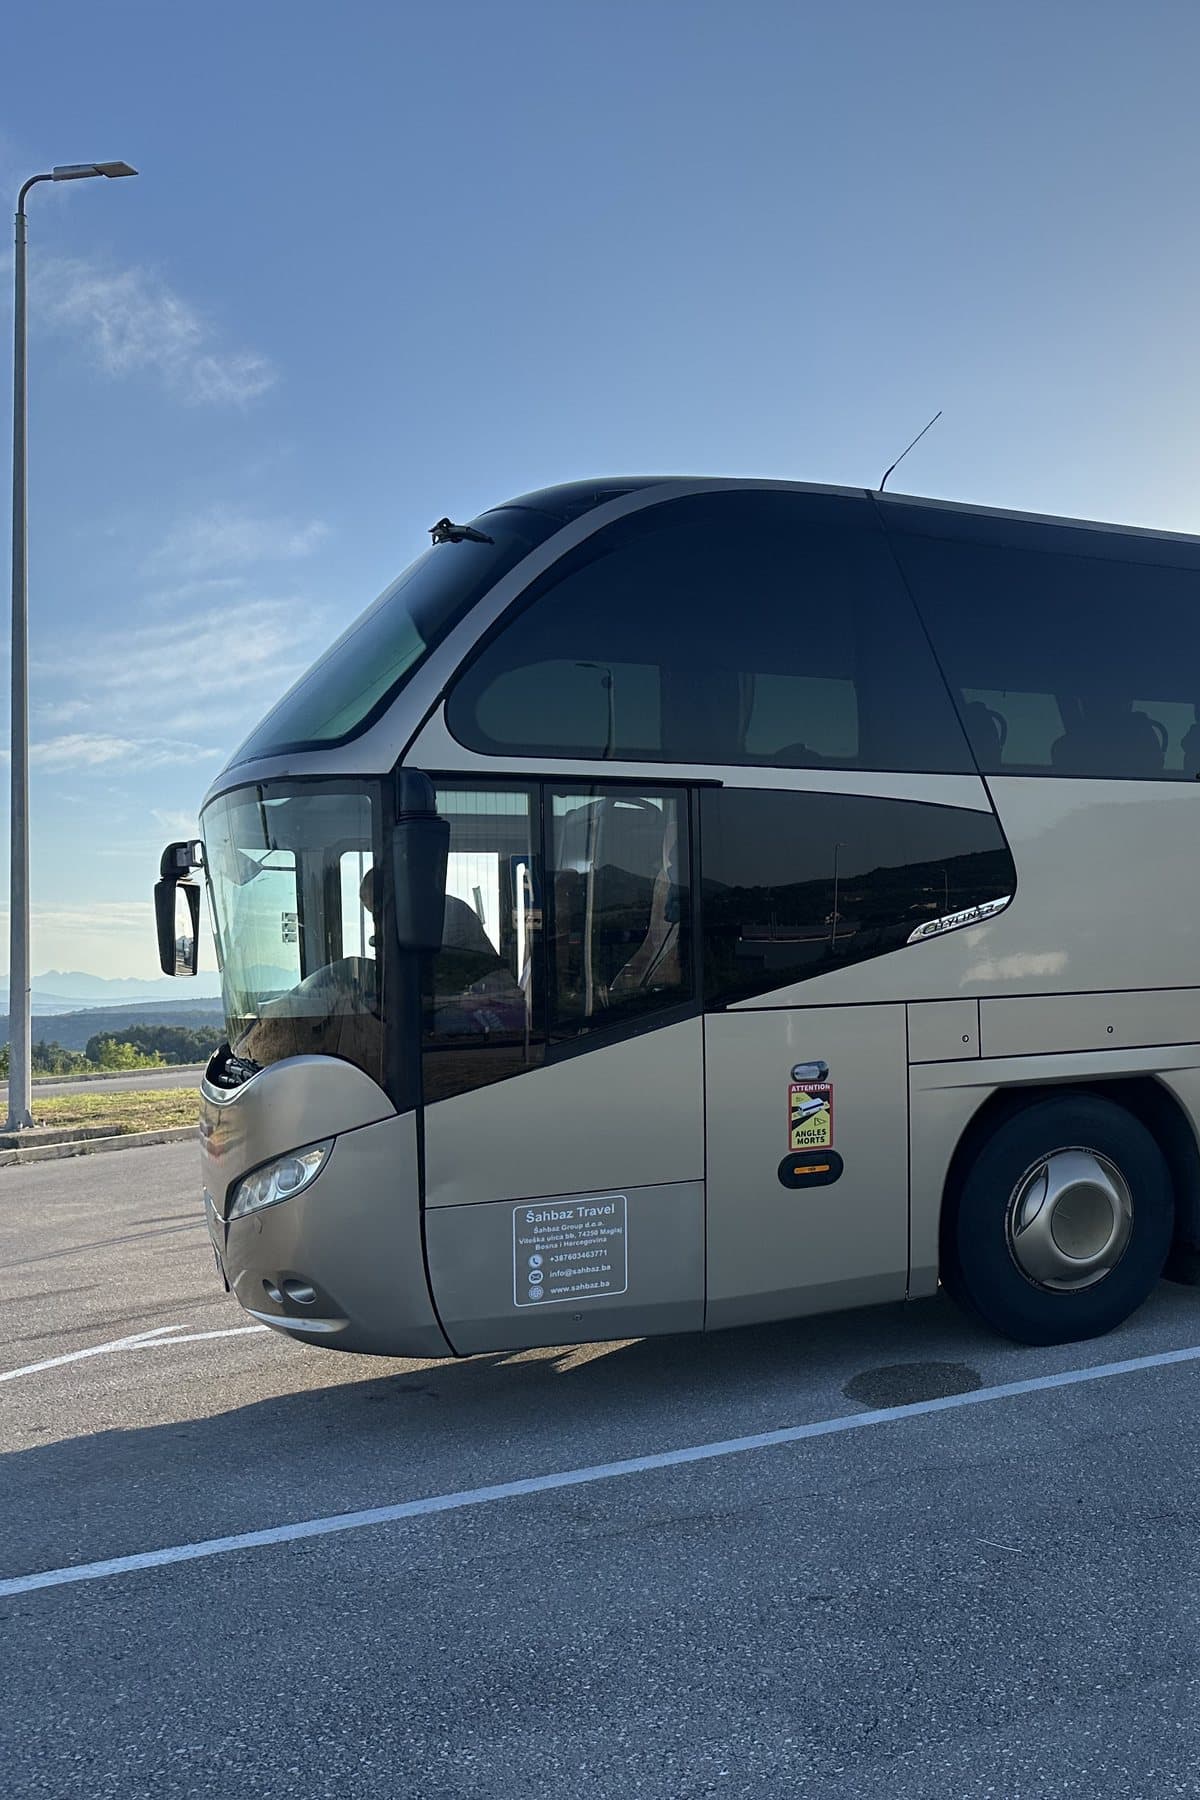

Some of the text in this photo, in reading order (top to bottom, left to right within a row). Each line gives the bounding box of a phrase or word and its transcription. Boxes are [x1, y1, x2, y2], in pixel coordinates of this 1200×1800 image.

[791, 1083, 831, 1092] ATTENTION
[795, 1128, 827, 1138] ANGLES
[797, 1136, 825, 1145] MORTS
[526, 1203, 615, 1223] Šahbaz Travel
[561, 1222, 583, 1231] Group
[535, 1242, 558, 1251] Bosna
[563, 1237, 607, 1248] Hercegovina
[549, 1264, 611, 1278] info@sahbaz.ba
[550, 1280, 610, 1295] www.sahbaz.ba
